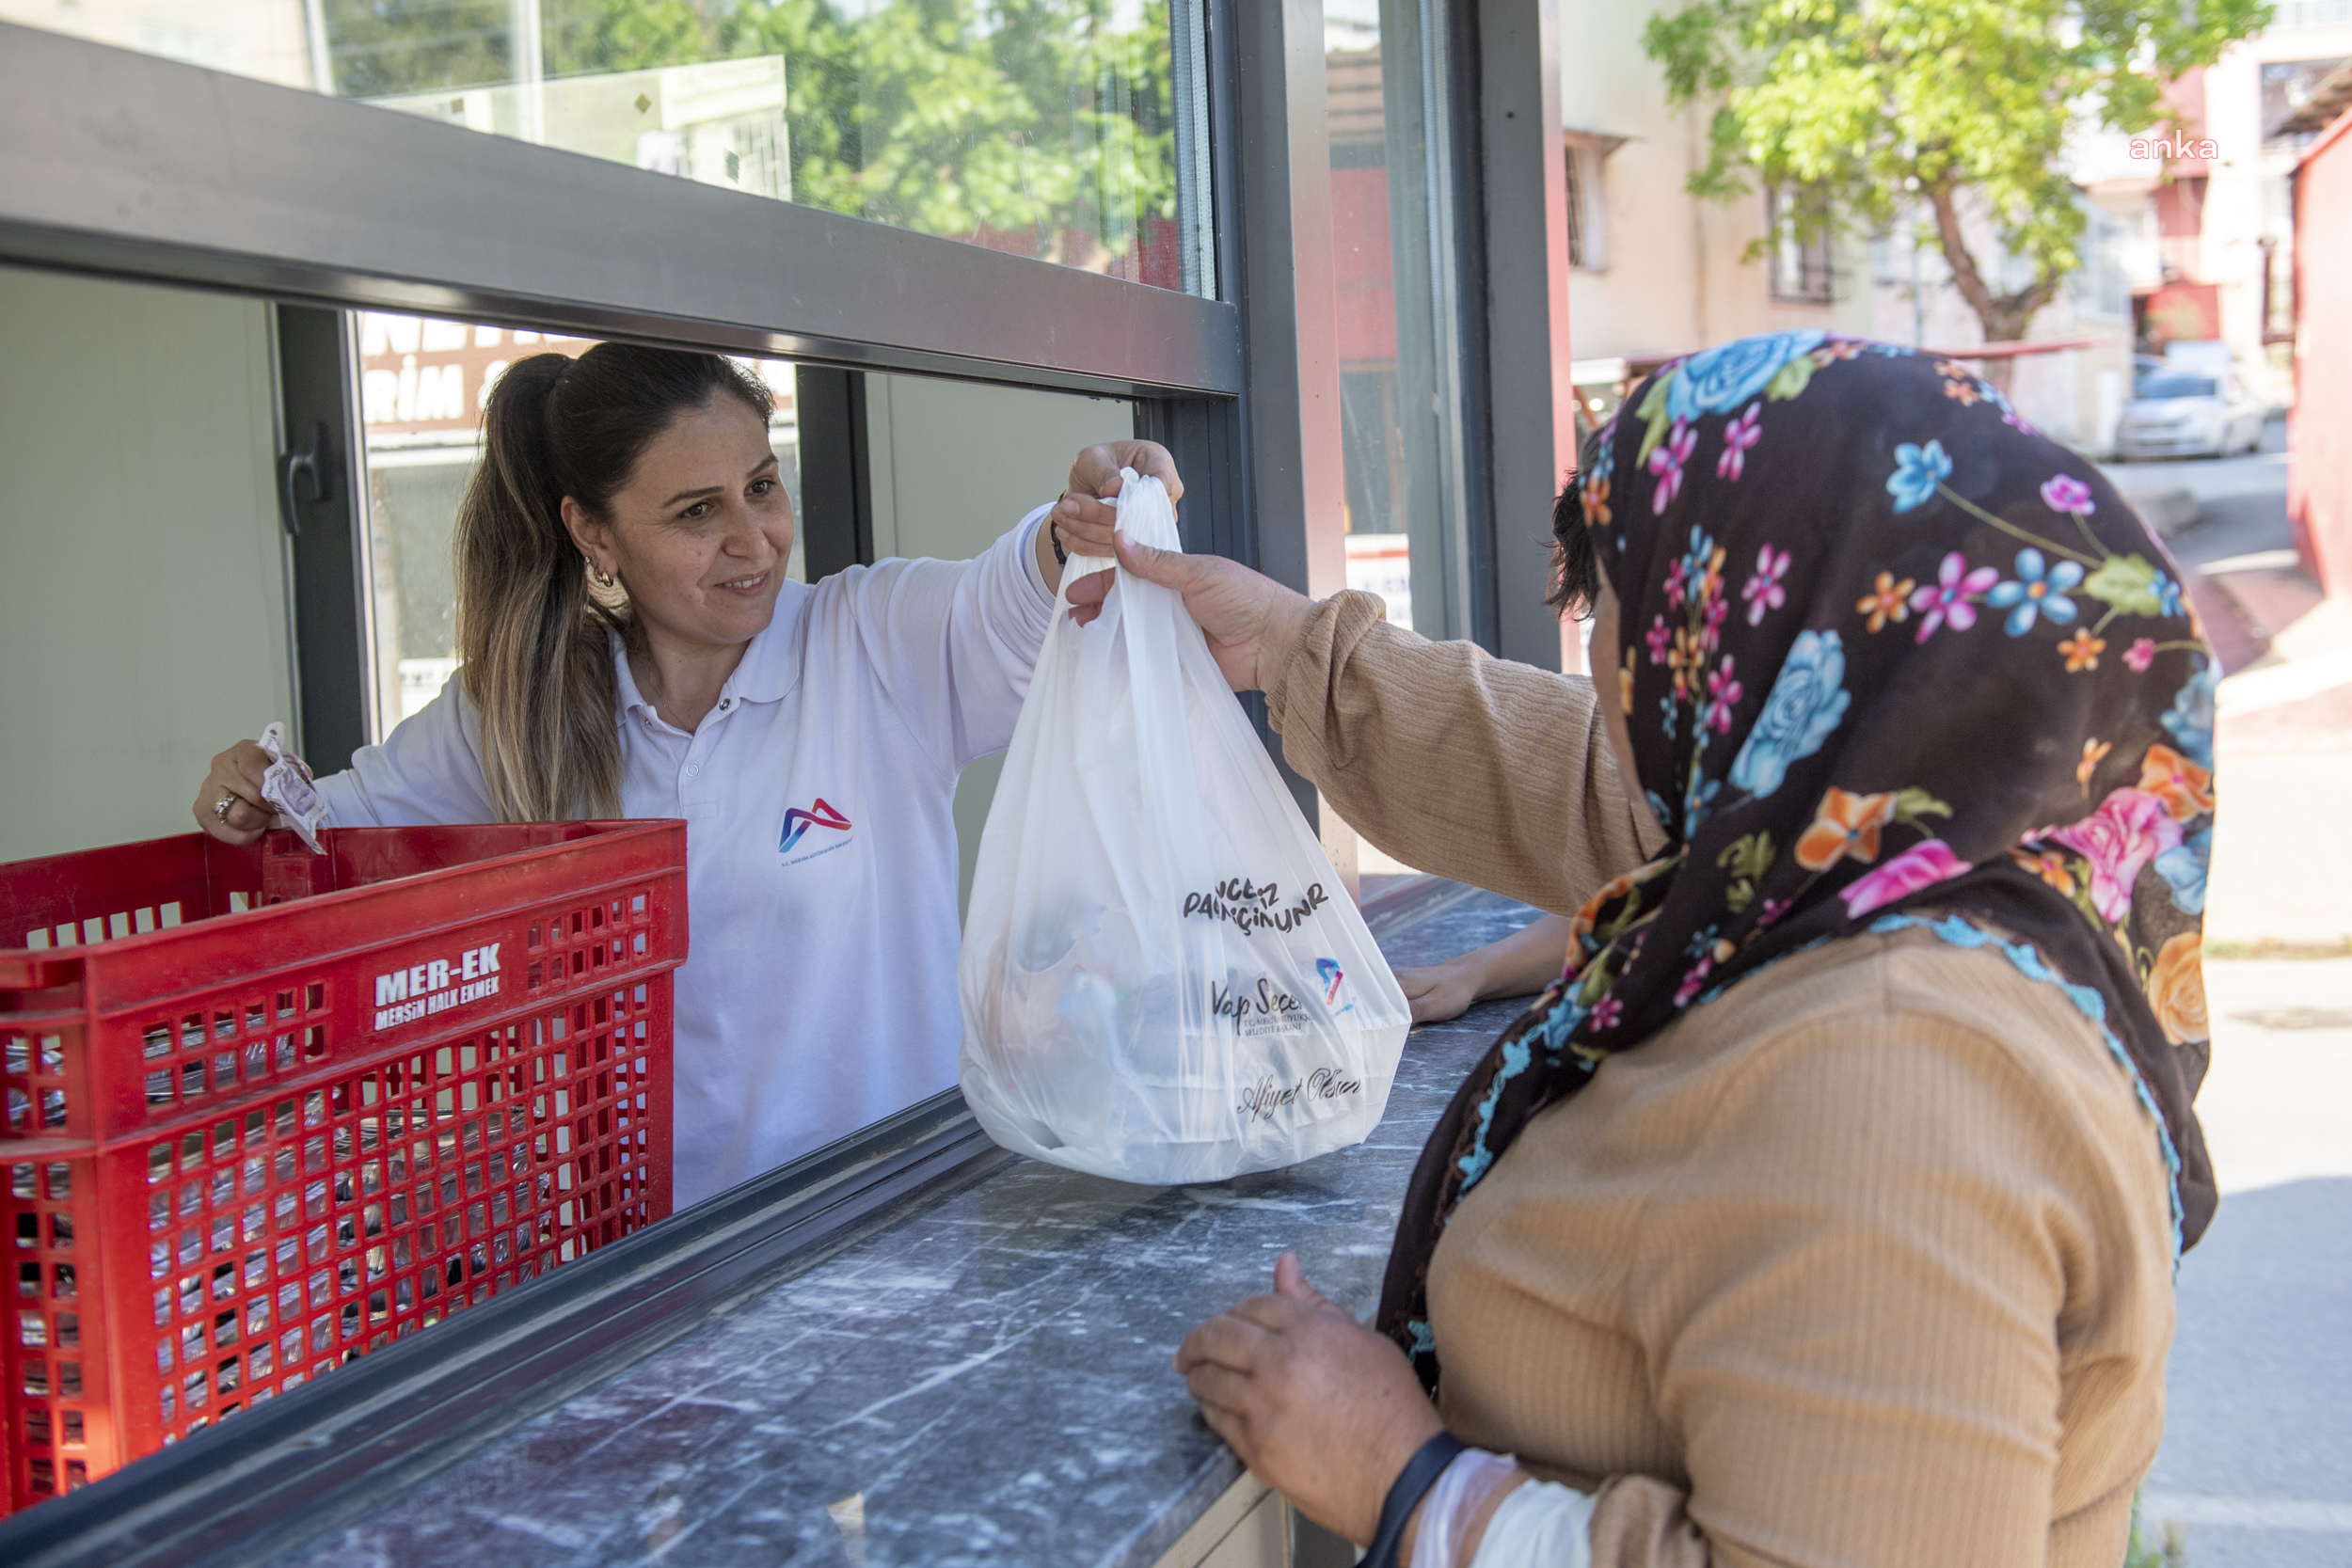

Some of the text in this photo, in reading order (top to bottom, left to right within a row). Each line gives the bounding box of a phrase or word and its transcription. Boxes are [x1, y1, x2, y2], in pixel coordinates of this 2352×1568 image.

[374, 942, 501, 1007] MER-EK
[427, 989, 458, 1015] HALK
[460, 975, 500, 1005] EKMEK
